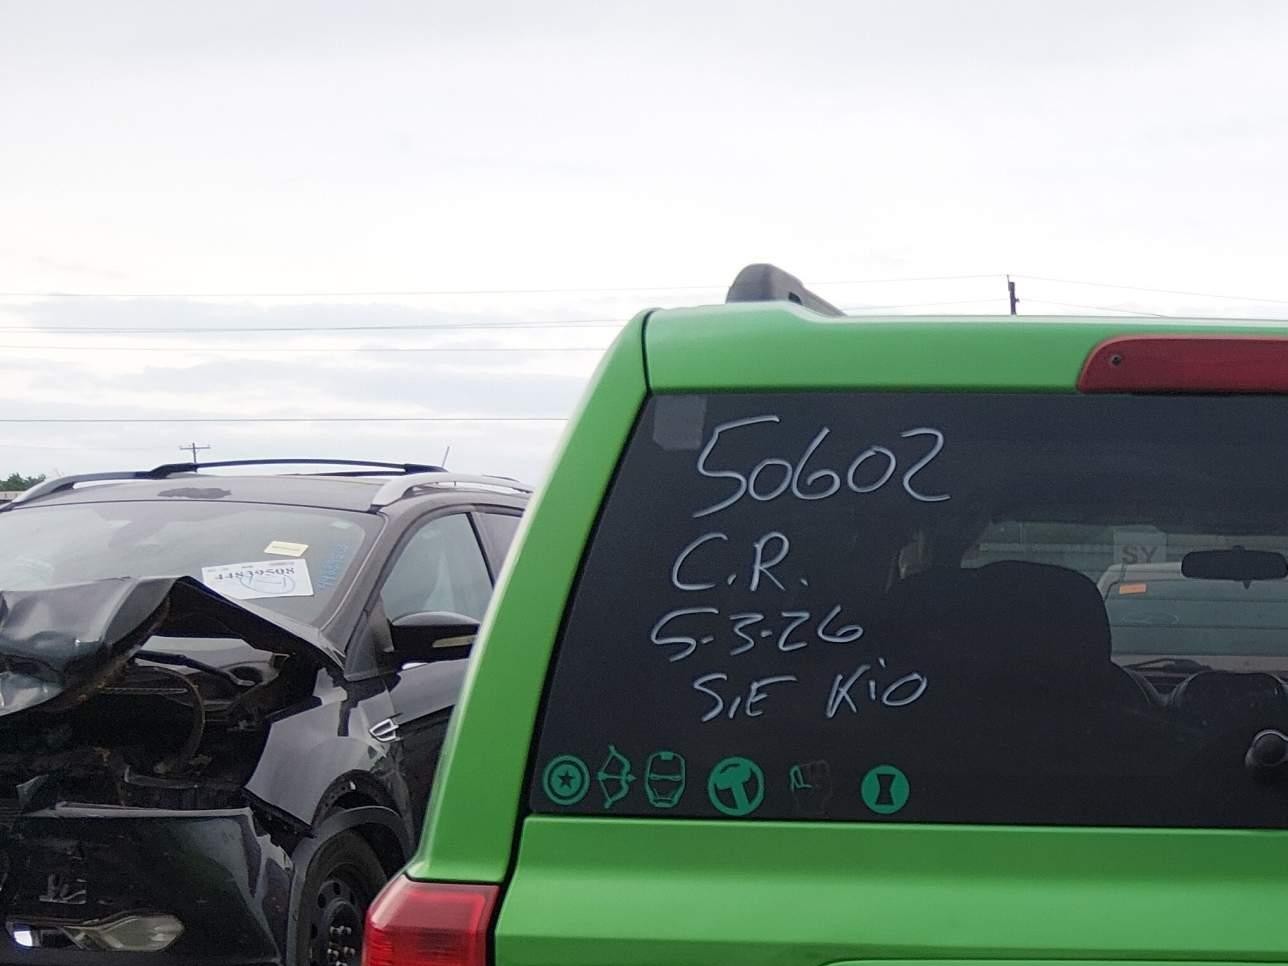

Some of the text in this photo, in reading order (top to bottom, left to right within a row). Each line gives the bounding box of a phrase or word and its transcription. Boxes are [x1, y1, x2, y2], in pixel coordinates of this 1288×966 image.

[692, 415, 951, 518] 50602
[671, 532, 809, 592] C.R.
[650, 605, 864, 662] 5-3-26
